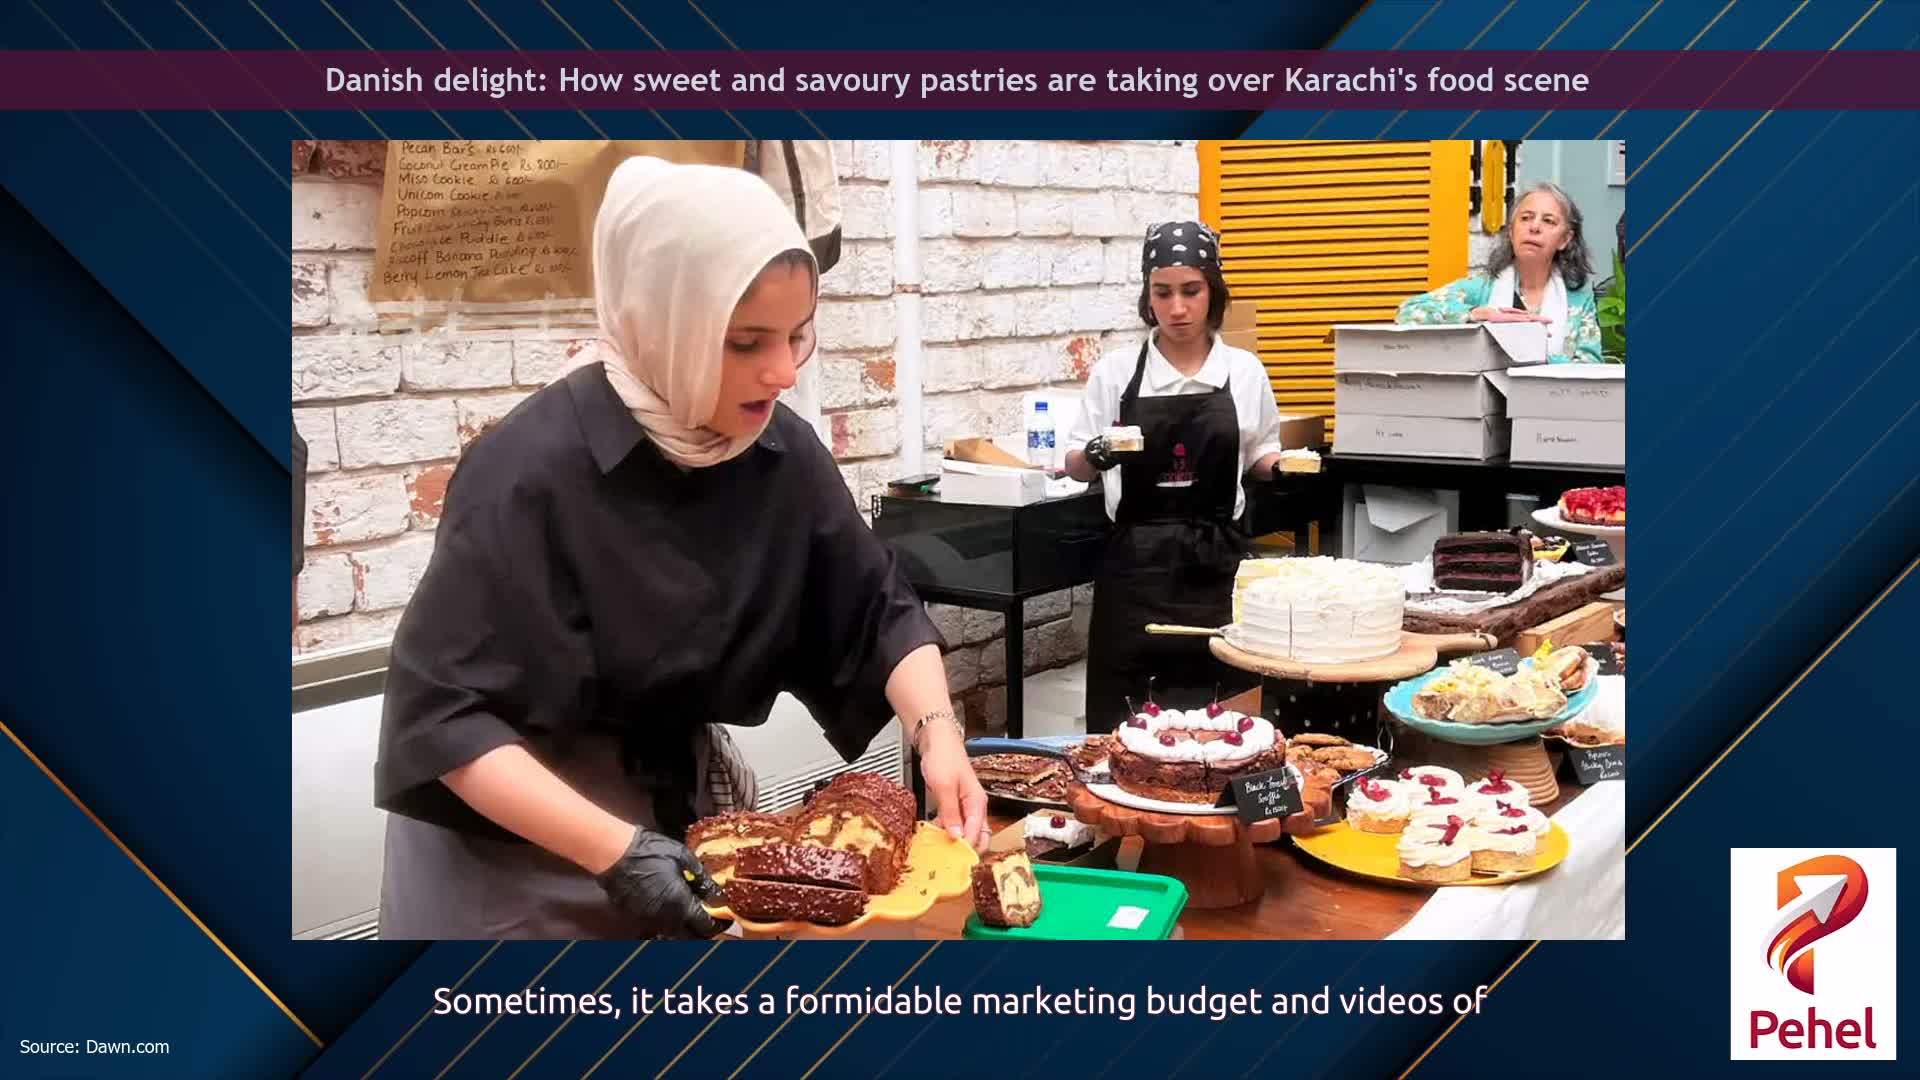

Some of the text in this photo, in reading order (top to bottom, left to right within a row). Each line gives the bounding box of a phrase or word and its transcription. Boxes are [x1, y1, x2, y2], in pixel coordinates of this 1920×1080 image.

[402, 142, 436, 154] Pecan
[490, 159, 510, 171] Pie
[398, 174, 428, 185] Miso
[432, 173, 475, 186] Cookie
[449, 188, 489, 201] Cookie
[424, 268, 469, 281] Lemon
